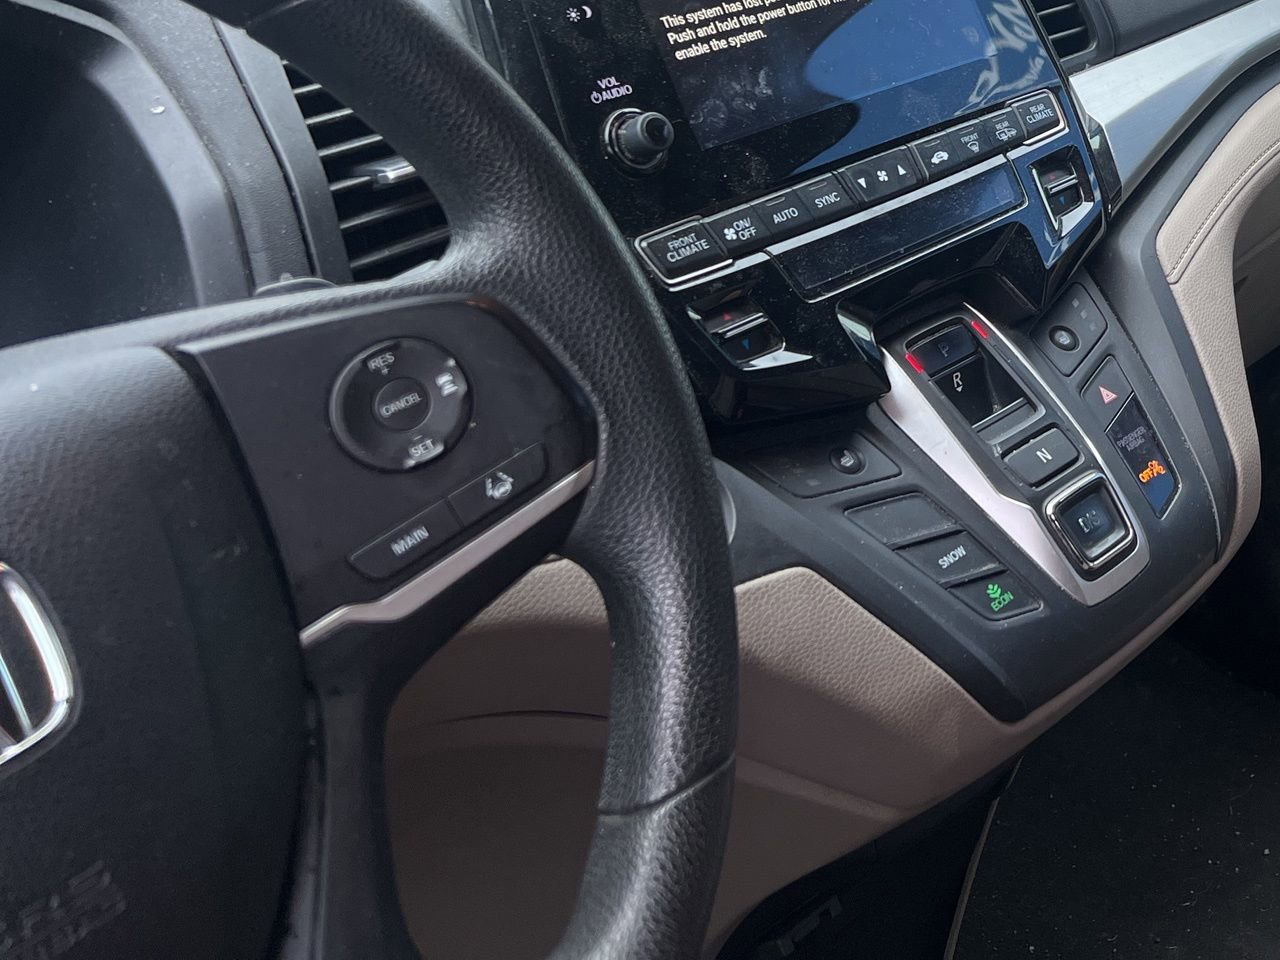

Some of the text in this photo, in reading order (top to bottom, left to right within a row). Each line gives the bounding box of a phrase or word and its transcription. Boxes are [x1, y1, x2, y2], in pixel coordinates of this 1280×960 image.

[660, 14, 686, 28] This
[686, 6, 723, 24] system
[722, 1, 743, 14] has
[667, 28, 696, 44] Push
[696, 22, 717, 37] and
[715, 17, 740, 32] hold
[739, 14, 757, 26] the
[757, 7, 787, 24] power
[785, 0, 817, 14] button
[675, 29, 767, 60] enable the system.
[597, 76, 620, 89] VOL
[601, 84, 633, 101] AUDIO
[1026, 108, 1054, 124] CLIMATE
[1029, 103, 1046, 114] REAR
[995, 121, 1010, 130] REAR
[960, 132, 979, 144] FRONT
[814, 192, 841, 208] SYNC
[733, 217, 752, 231] ON/
[772, 207, 799, 224] AUTO
[667, 233, 698, 251] FRONT
[738, 227, 757, 241] OFF
[666, 239, 710, 263] CLIMATE
[368, 352, 395, 371] RES
[952, 372, 963, 388] R
[381, 392, 421, 418] CANCEL
[410, 439, 434, 457] SET
[1036, 447, 1053, 463] N
[391, 525, 430, 556] MAIN
[938, 545, 967, 569] SNOW
[991, 591, 1014, 612] ECON
